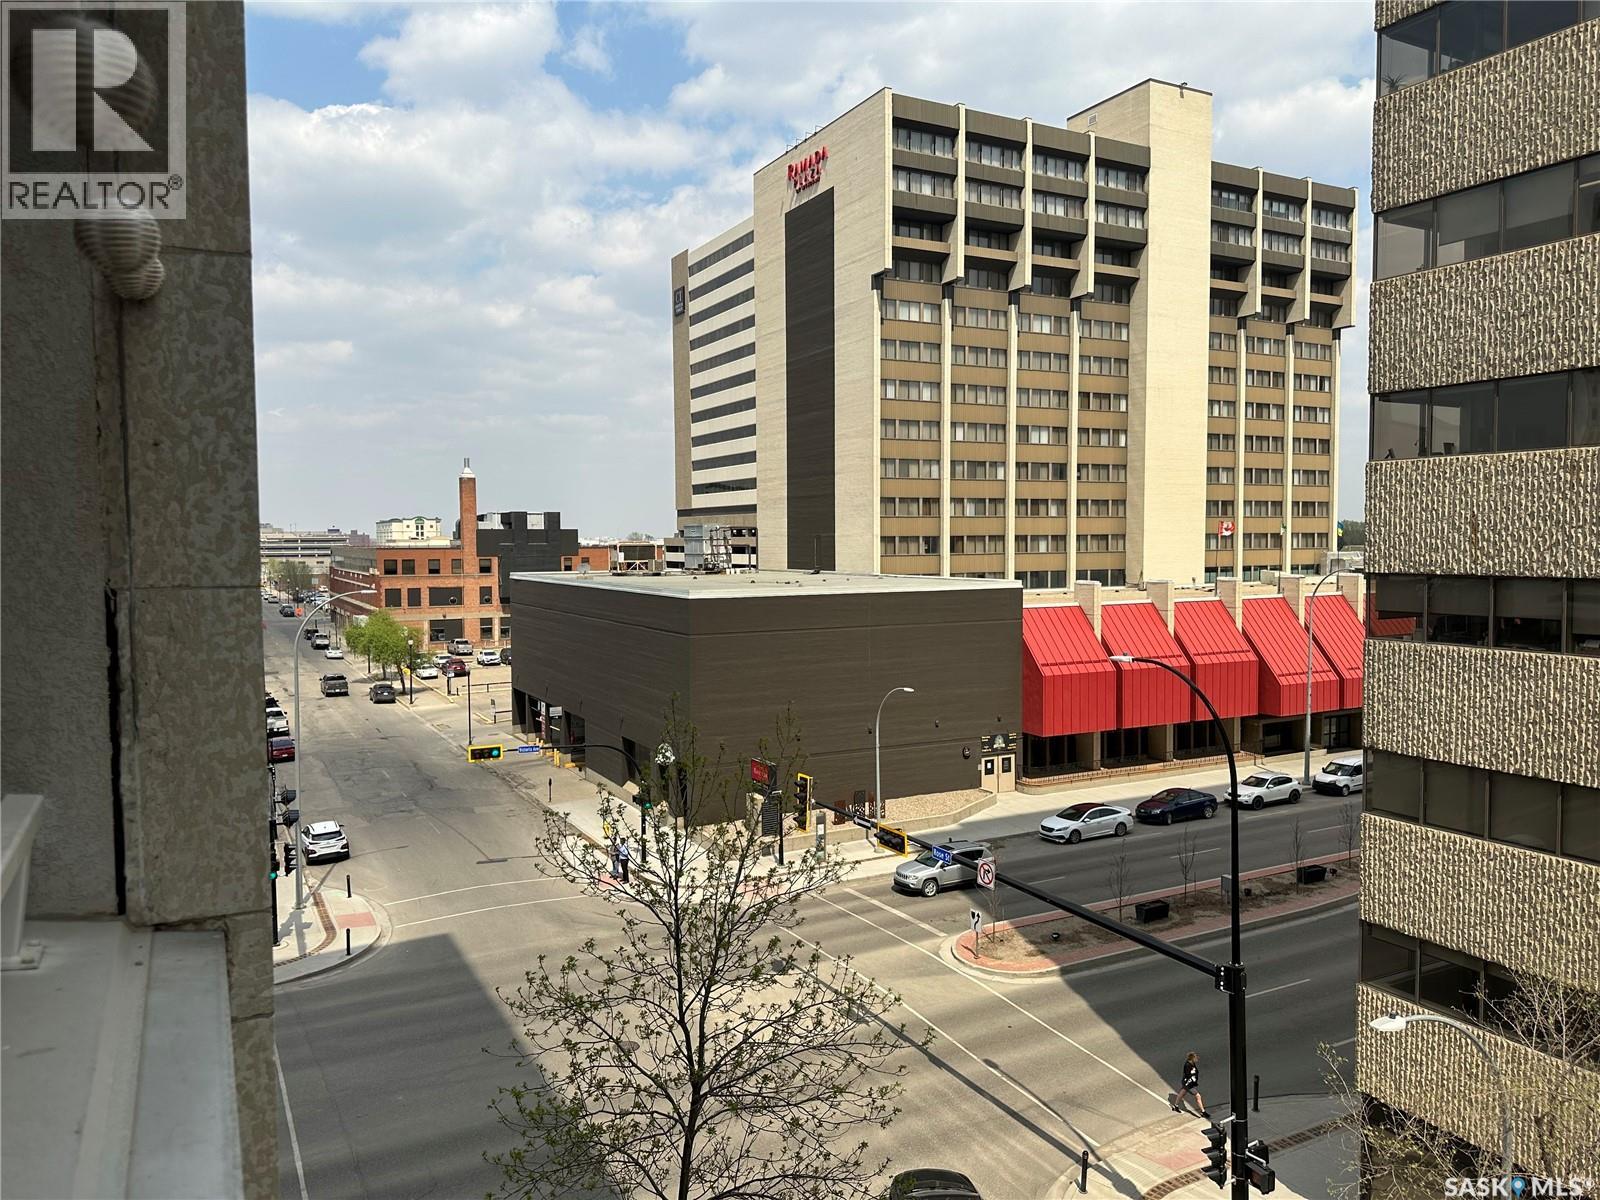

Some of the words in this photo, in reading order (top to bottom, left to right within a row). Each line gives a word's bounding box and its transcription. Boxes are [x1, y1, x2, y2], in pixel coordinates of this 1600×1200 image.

[787, 145, 829, 181] RAMADA
[933, 848, 944, 859] Rose
[944, 852, 950, 861] St
